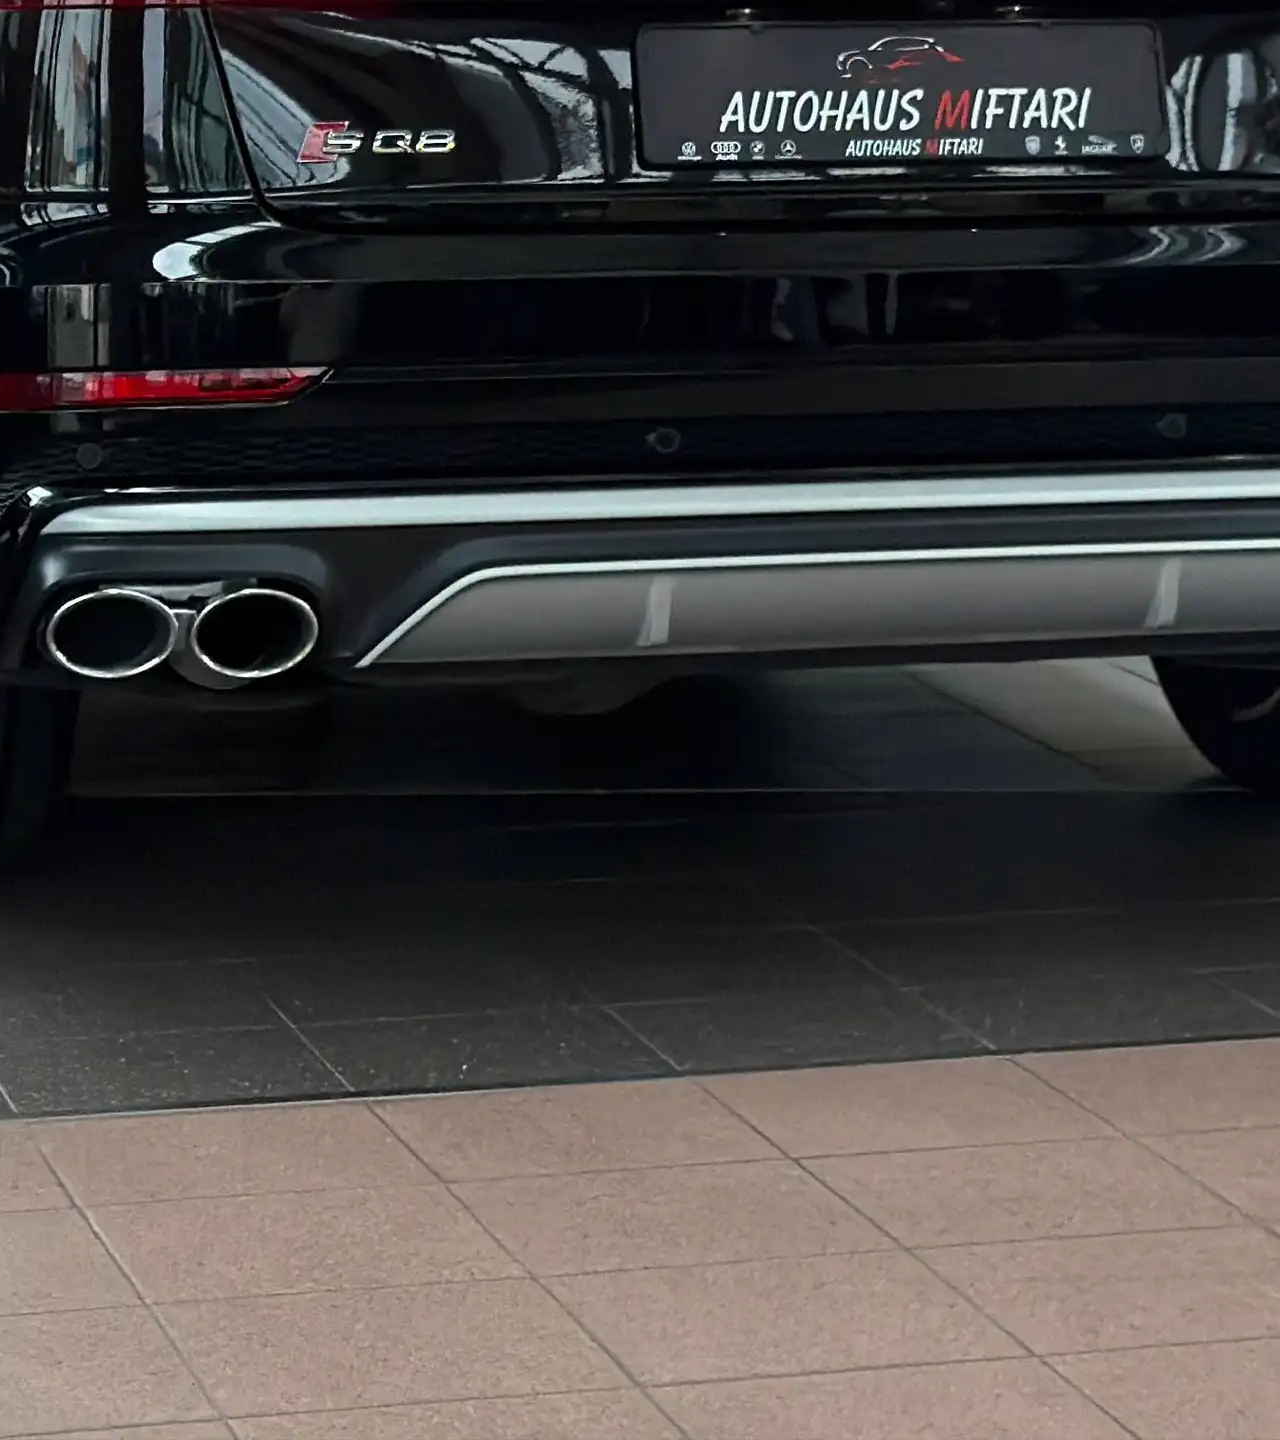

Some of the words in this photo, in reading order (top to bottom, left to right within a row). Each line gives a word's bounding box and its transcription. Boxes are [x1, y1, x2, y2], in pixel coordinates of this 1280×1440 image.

[720, 89, 924, 133] AUTOHAUS
[934, 87, 1091, 131] MIFTARI
[320, 127, 456, 156] SQ8
[845, 138, 922, 158] AUTOHAUS
[924, 137, 984, 157] MIFTARI
